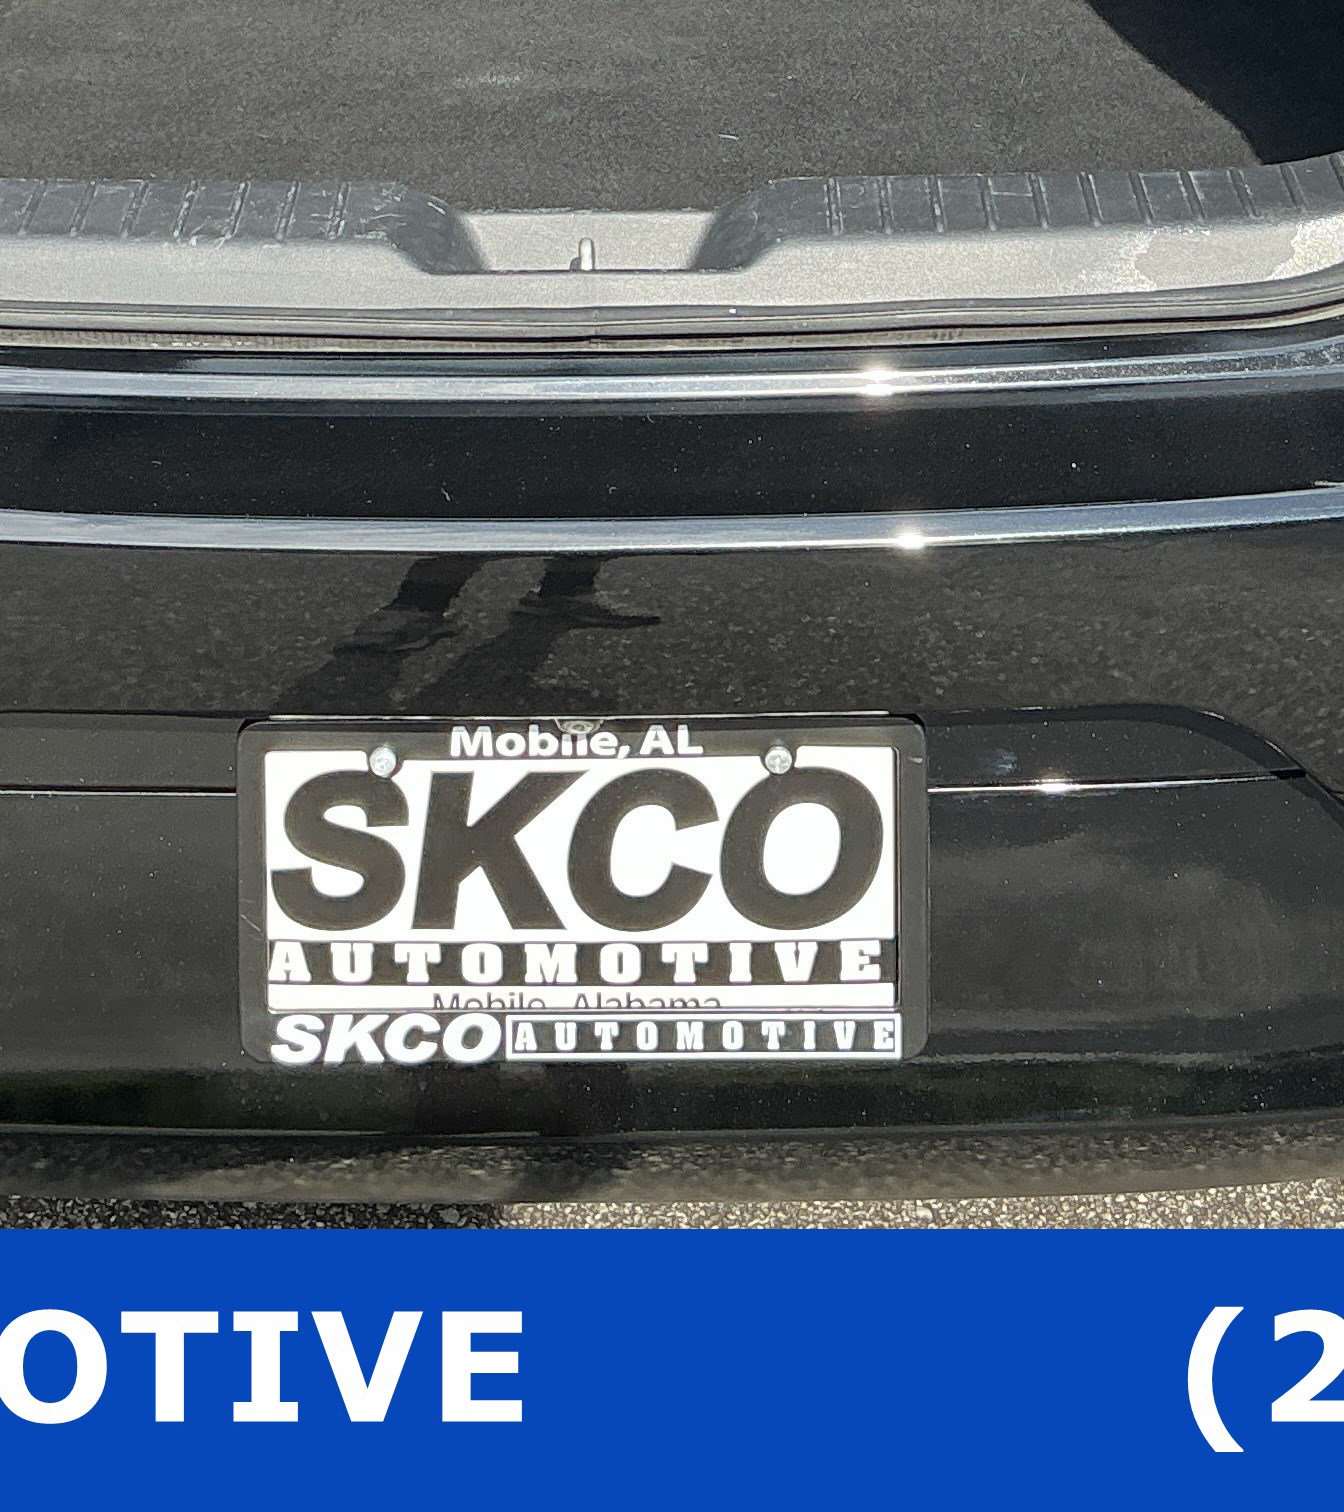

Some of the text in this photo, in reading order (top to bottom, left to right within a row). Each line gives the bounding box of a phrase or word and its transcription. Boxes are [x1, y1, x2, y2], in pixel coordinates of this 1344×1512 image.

[450, 724, 704, 759] Mobile, AL
[270, 766, 884, 932] SKCO
[268, 940, 882, 984] AUTOMOTIVE
[270, 1012, 895, 1064] SKCO AUTOMOTIVE
